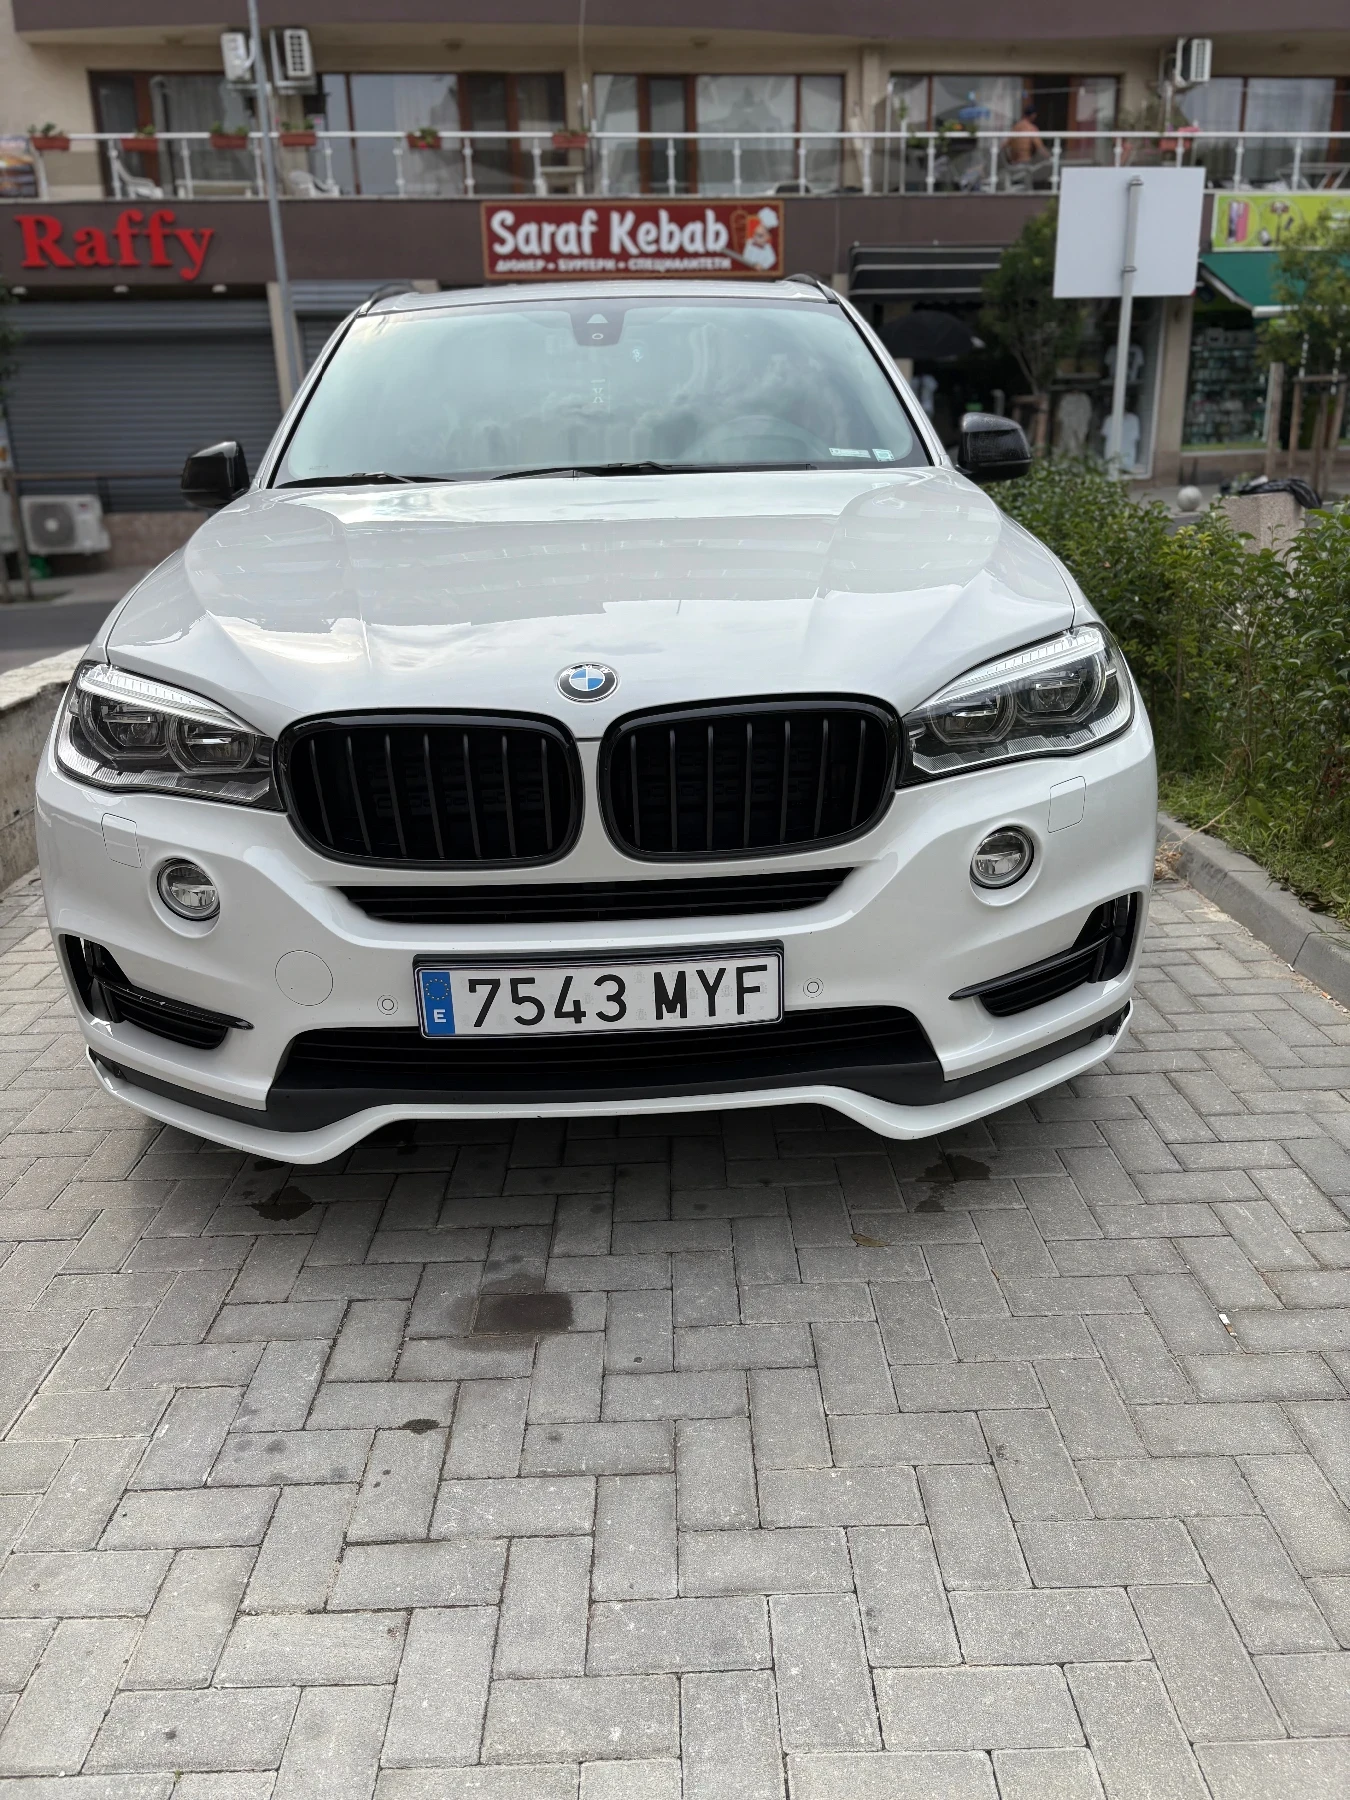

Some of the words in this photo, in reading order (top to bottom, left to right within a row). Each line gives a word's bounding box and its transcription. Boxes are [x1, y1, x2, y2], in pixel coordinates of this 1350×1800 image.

[14, 208, 214, 281] Raffy
[490, 208, 598, 256] Saraf
[609, 208, 729, 256] Kebab
[433, 1008, 447, 1023] E
[468, 973, 627, 1028] 7543
[653, 964, 768, 1021] MYF
